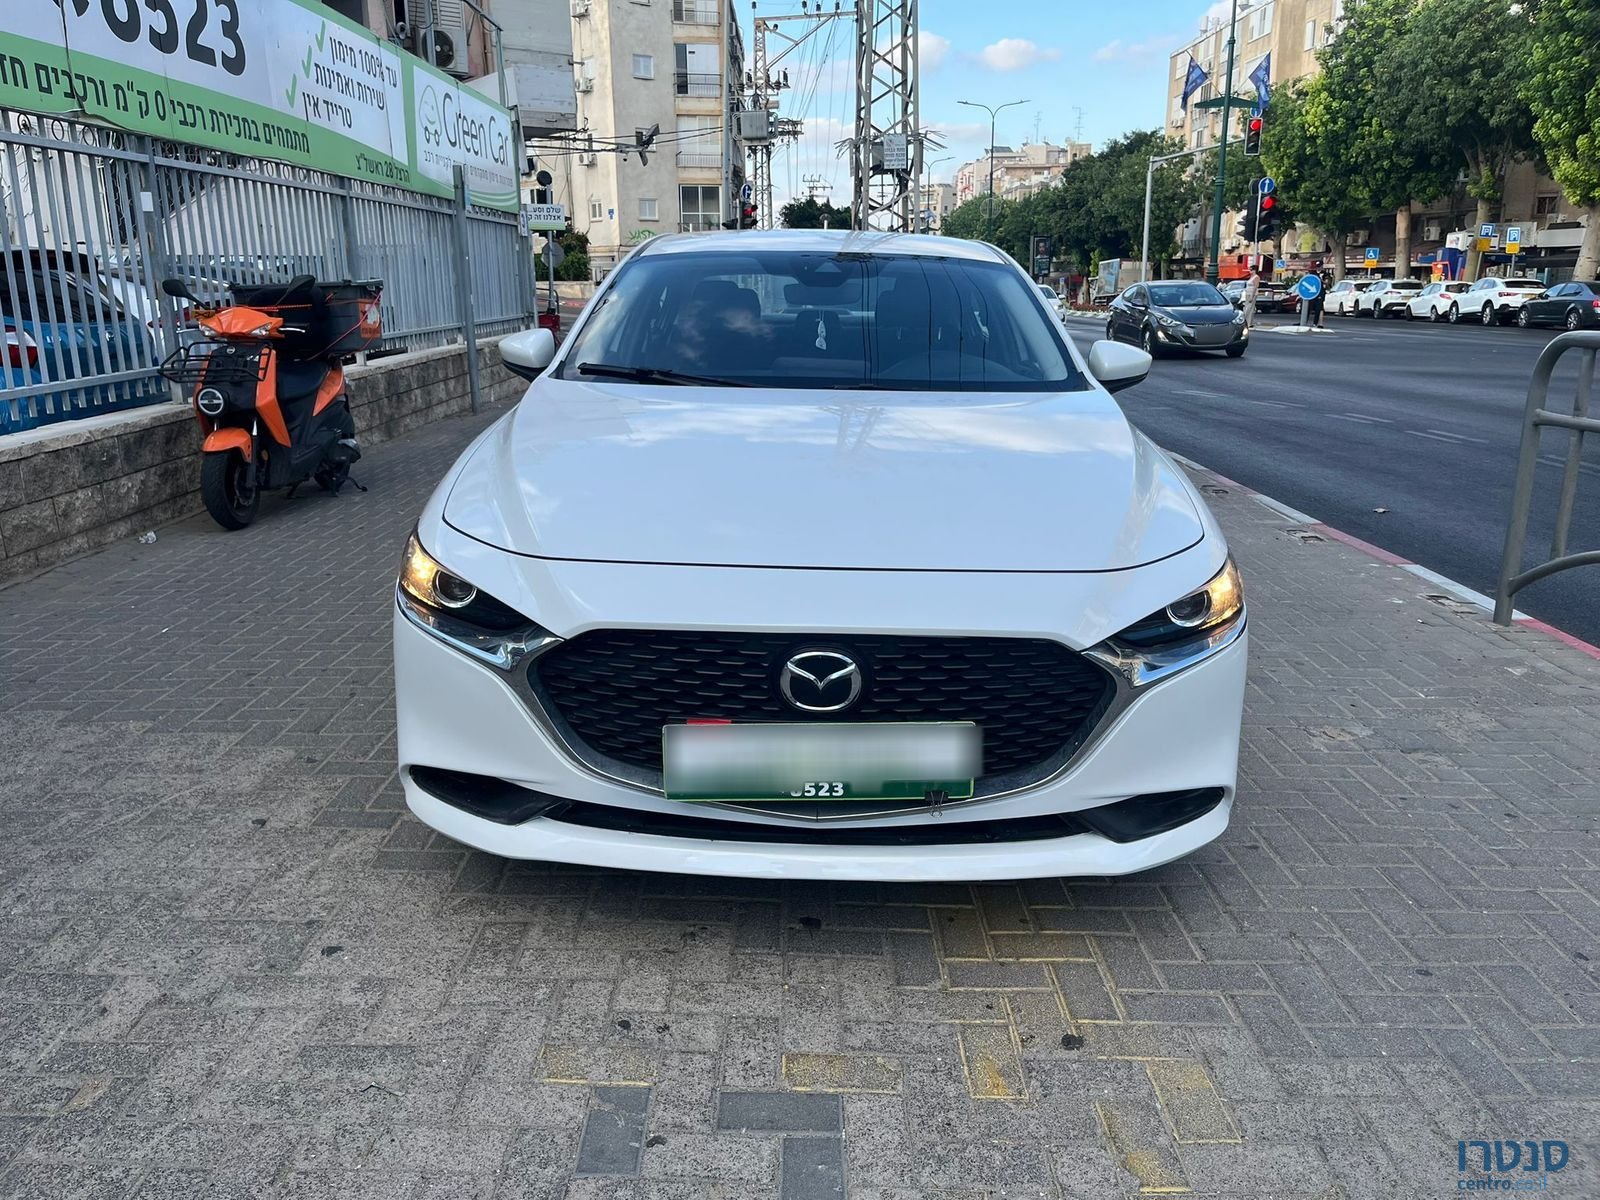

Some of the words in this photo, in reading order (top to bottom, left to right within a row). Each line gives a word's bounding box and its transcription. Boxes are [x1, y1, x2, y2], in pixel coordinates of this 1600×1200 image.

[329, 36, 356, 68] מימון
[359, 49, 384, 81] 100%
[34, 62, 108, 107] ורכבים
[314, 62, 355, 99] ואמינות
[386, 66, 397, 88] עד
[154, 90, 166, 121] 0
[302, 91, 321, 122] אין
[356, 82, 384, 110] שירות
[169, 98, 206, 130] רכבי
[208, 108, 260, 142] במכירת
[323, 99, 352, 128] טרייד
[263, 122, 310, 153] מתמחים
[442, 92, 488, 159] Green
[488, 115, 509, 167] Car
[384, 161, 394, 178] 28
[546, 206, 561, 214] שלם
